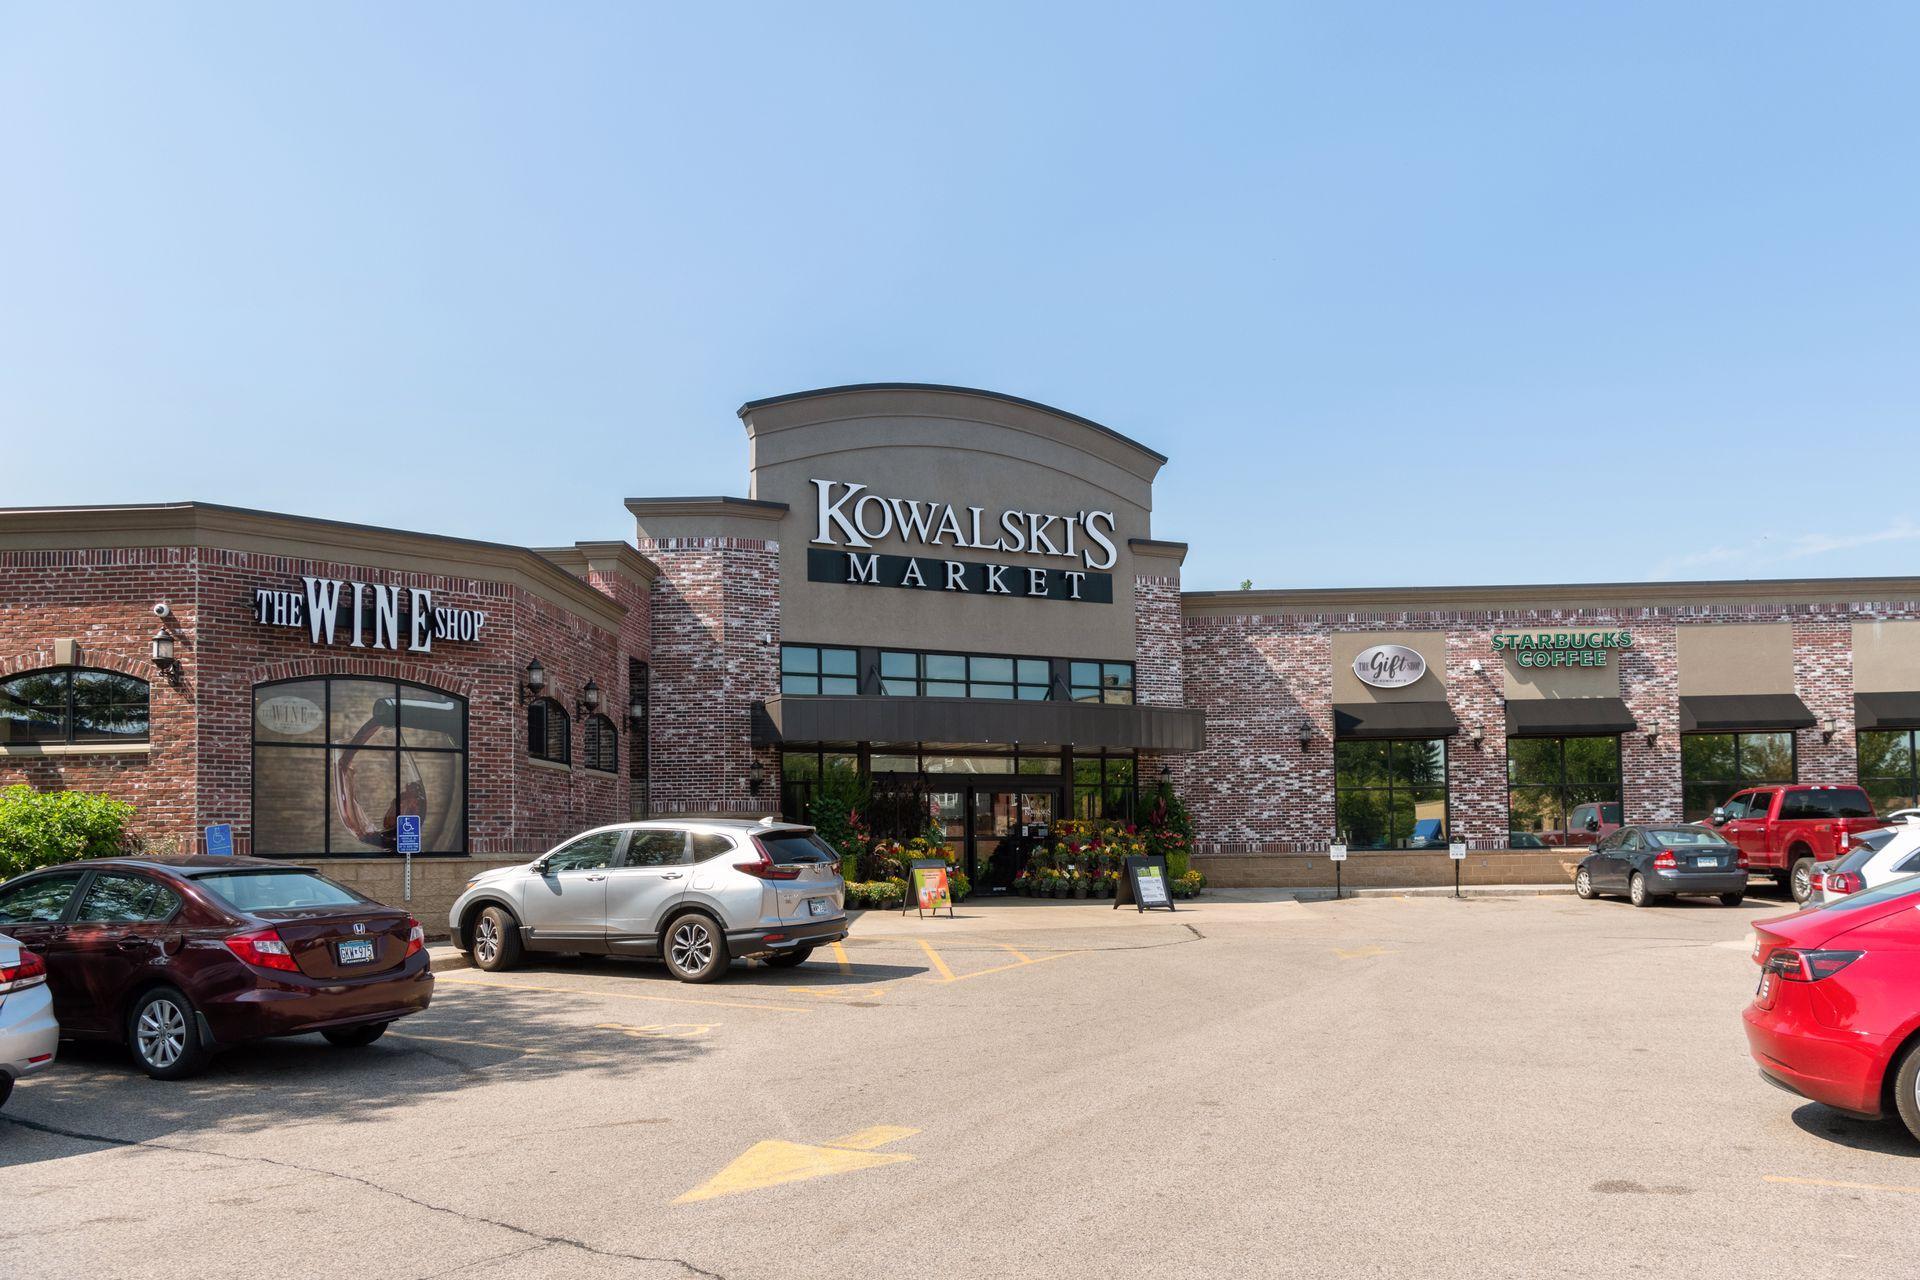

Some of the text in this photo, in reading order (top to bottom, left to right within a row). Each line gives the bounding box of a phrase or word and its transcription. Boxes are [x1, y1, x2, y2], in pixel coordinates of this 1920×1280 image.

[810, 478, 1117, 570] KOWALSKI'S
[847, 552, 1085, 599] MARKET
[256, 576, 485, 653] THE WINE SHOP
[1491, 632, 1633, 651] STARBUCKS
[1358, 662, 1369, 671] THE
[1370, 651, 1406, 679] Gift
[1517, 650, 1608, 667] COFFEE
[272, 704, 308, 723] WINE
